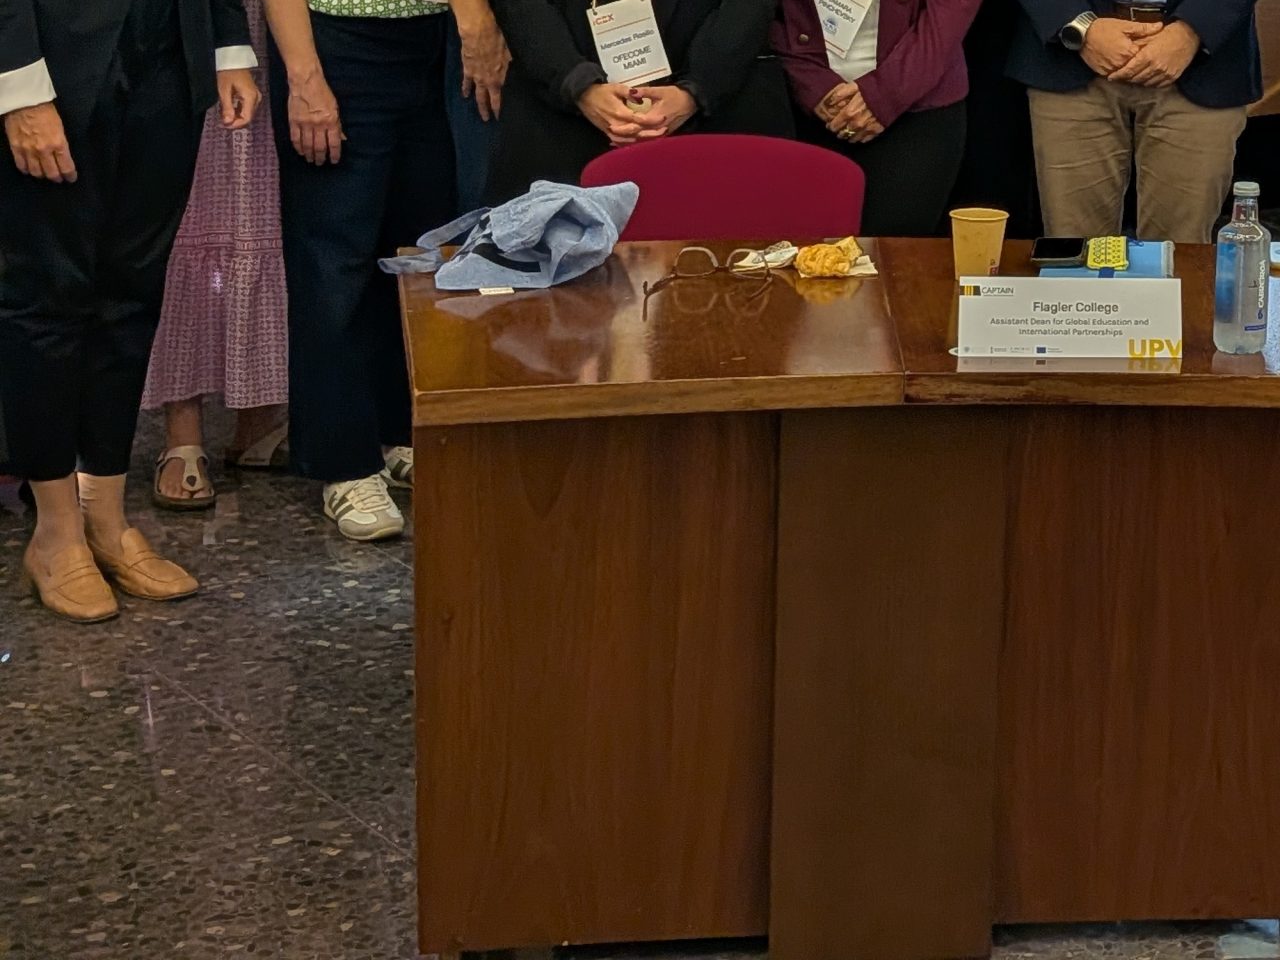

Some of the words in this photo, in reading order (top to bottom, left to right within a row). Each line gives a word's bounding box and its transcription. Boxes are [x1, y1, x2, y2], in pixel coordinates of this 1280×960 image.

[623, 58, 646, 70] MIAMI
[982, 287, 1014, 295] CAPTAIN
[1032, 301, 1073, 314] Flagler
[1076, 302, 1119, 314] College
[1065, 318, 1090, 326] Global
[1092, 318, 1132, 326] Education
[1019, 328, 1070, 336] International
[1072, 328, 1123, 337] Partnerships
[1128, 339, 1182, 358] UPV
